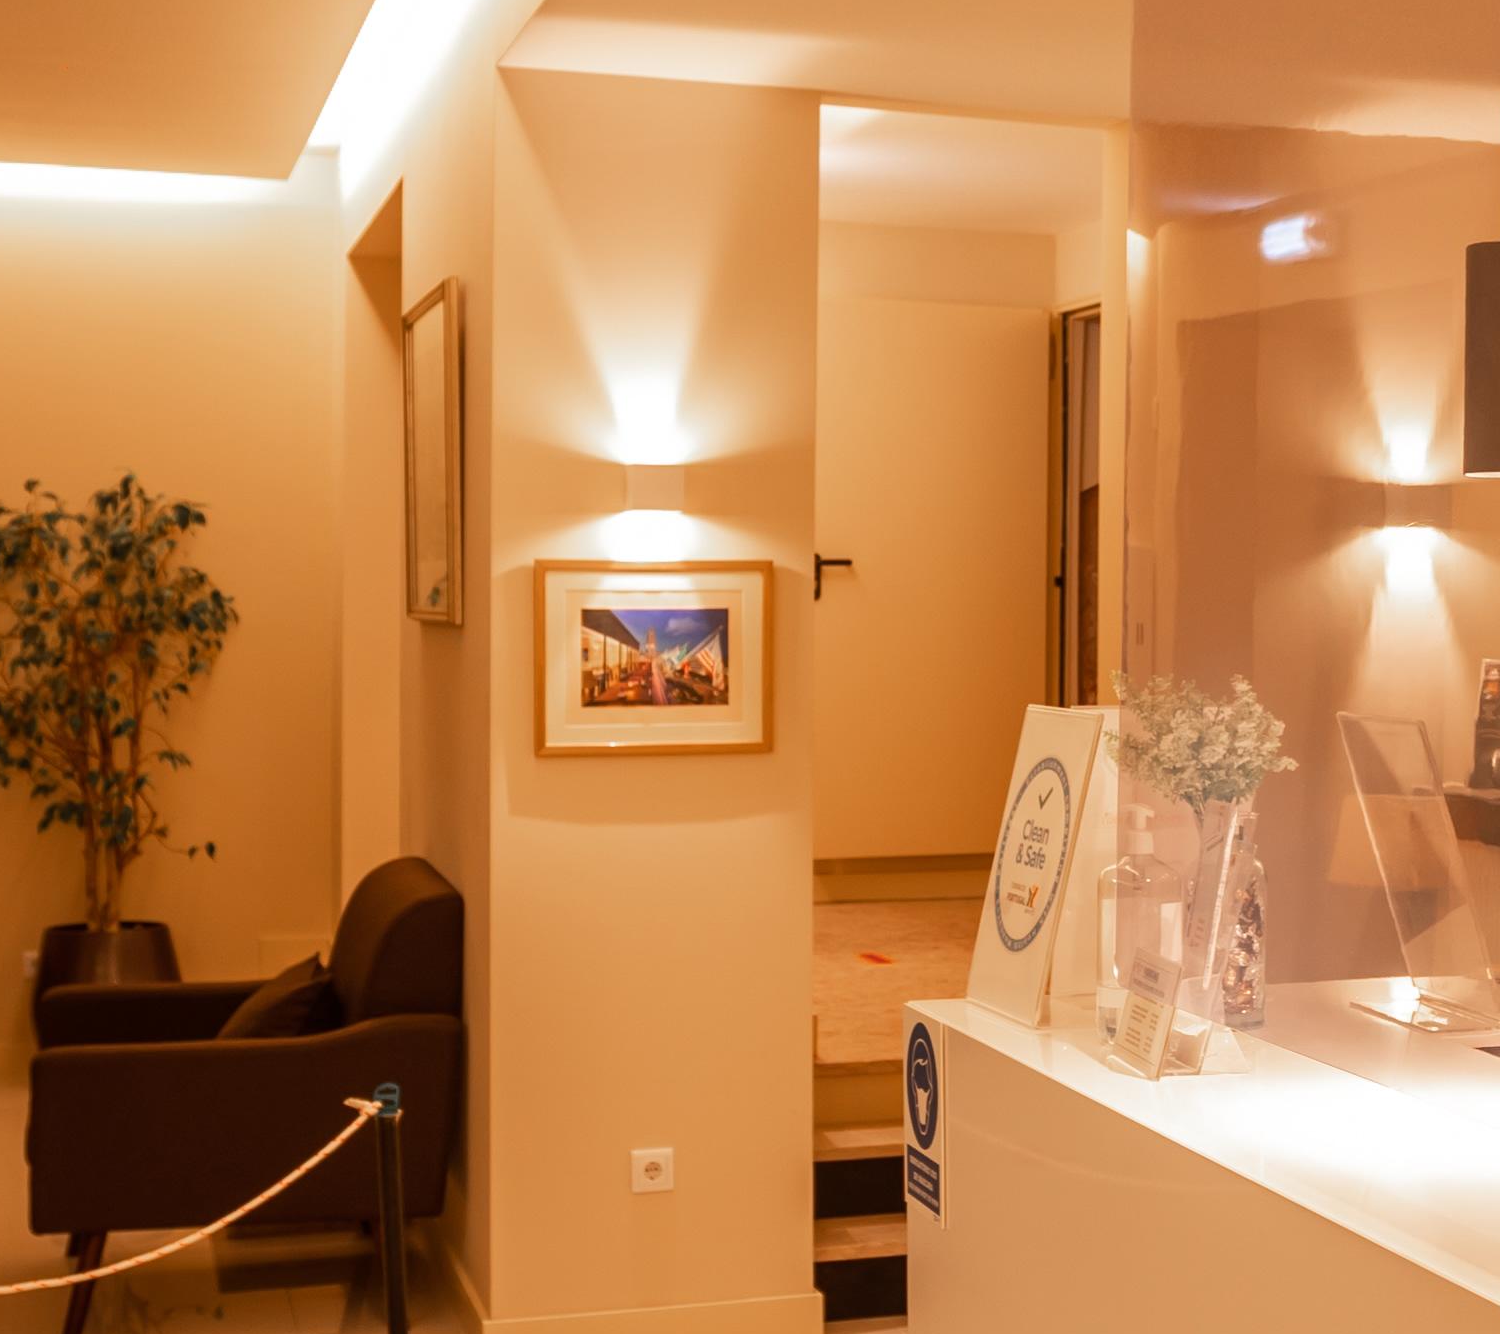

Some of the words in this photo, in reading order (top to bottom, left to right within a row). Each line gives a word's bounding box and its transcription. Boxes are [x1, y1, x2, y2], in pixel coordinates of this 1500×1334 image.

[1023, 820, 1049, 844] Clean
[1016, 843, 1023, 864] &
[1024, 845, 1046, 870] Safe
